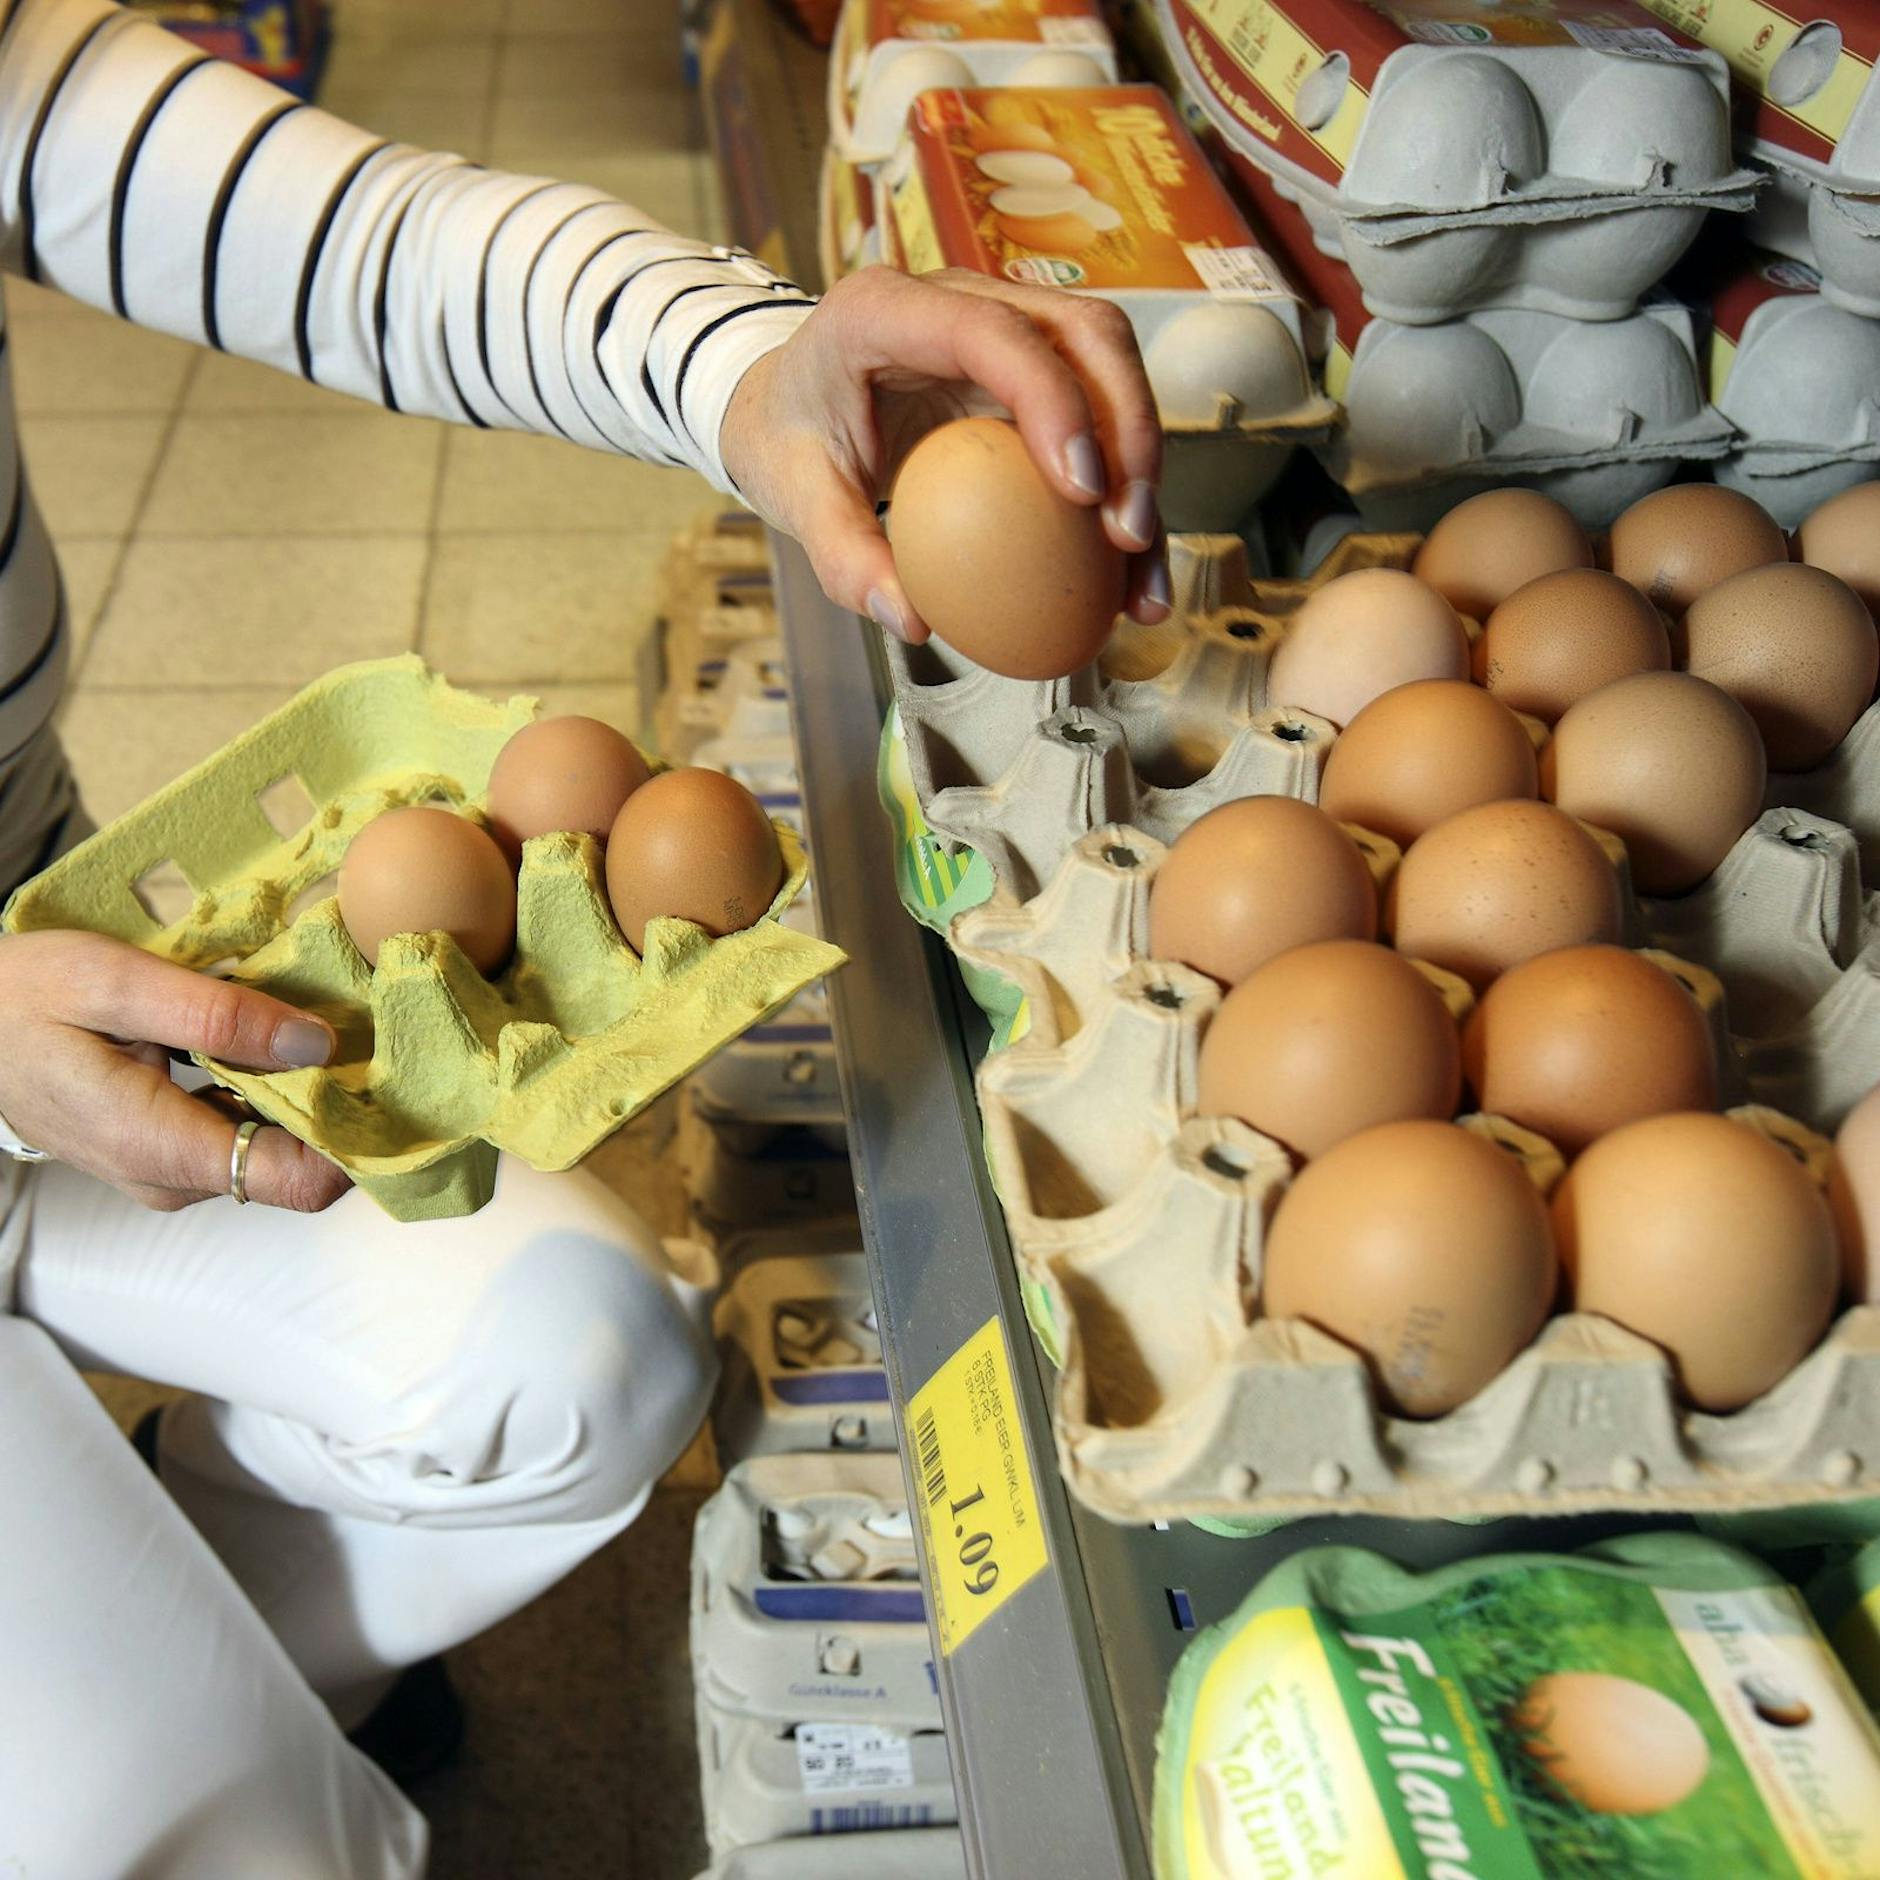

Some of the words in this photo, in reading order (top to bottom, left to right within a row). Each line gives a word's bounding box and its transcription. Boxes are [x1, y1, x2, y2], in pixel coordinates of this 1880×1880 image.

[972, 1359, 981, 1371] 6
[974, 1370, 987, 1400] STK
[980, 1398, 992, 1421] PG
[982, 1349, 1003, 1418] FREILAND
[995, 1417, 1011, 1454] EIER
[1003, 1454, 1020, 1500] GWKL
[950, 1483, 999, 1595] 1.09
